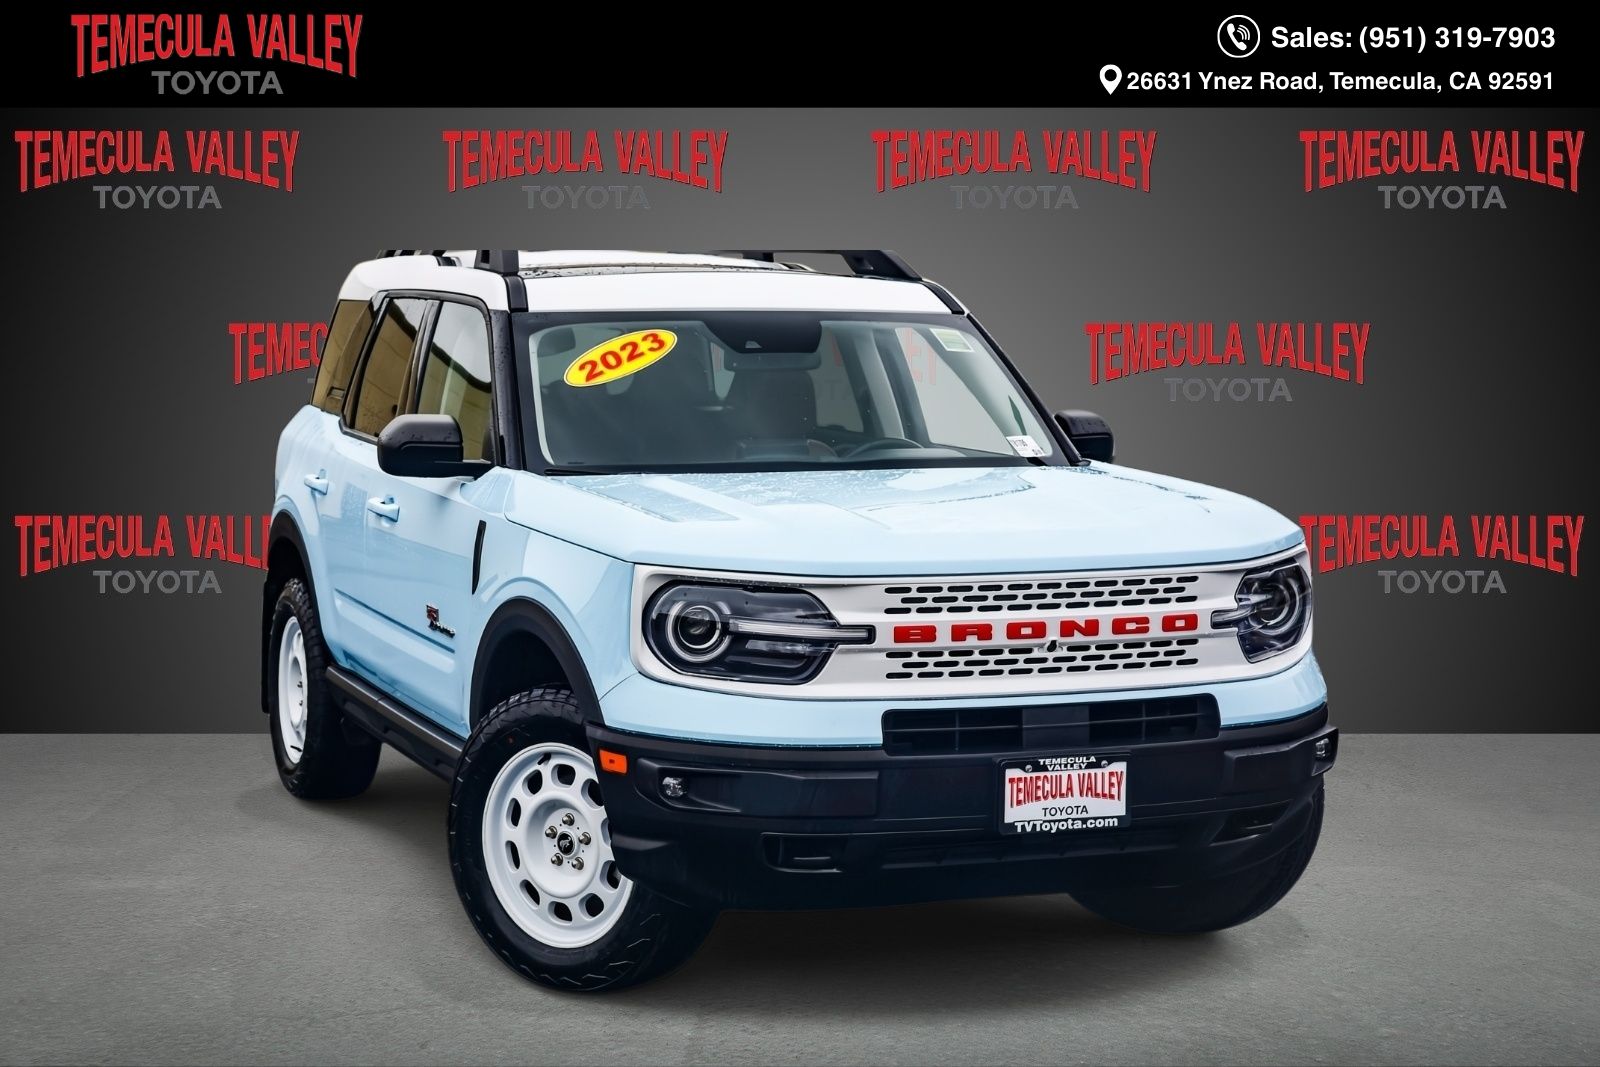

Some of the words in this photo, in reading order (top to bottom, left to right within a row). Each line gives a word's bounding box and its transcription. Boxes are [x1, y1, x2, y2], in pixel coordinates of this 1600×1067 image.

[14, 129, 174, 193] TEMECULA
[186, 129, 299, 193] VALLEY
[442, 129, 602, 193] TEMECULA
[614, 129, 728, 193] VALLEY
[871, 129, 1031, 193] TEMECULA
[1043, 129, 1156, 193] VALLEY
[1299, 129, 1459, 193] TEMECULA
[1471, 129, 1583, 193] VALLEY
[93, 185, 222, 209] TOYOTA
[521, 185, 650, 209] TOYOTA
[950, 185, 1079, 209] TOYOTA
[1378, 185, 1507, 209] TOYOTA
[228, 321, 329, 385] TEMEC
[578, 332, 665, 382] 2023
[1084, 322, 1244, 386] TEMECULA
[1256, 322, 1370, 386] VALLEY
[1163, 378, 1292, 402] TOYOTA
[14, 514, 174, 577] TEMECULA
[186, 514, 272, 571] VALL
[1299, 514, 1459, 574] TEMECULA
[1471, 514, 1583, 577] VALLEY
[93, 570, 222, 594] TOYOTA
[1378, 570, 1507, 594] TOYOTA
[893, 613, 1199, 644] BRONCO
[1038, 756, 1096, 766] TEMECULA
[1047, 763, 1087, 771] VALLEY
[1008, 774, 1074, 808] TEMECULA
[1078, 771, 1124, 801] VALLEY
[1042, 805, 1089, 817] TOYOTA
[1014, 817, 1118, 833] TVToyota.com
